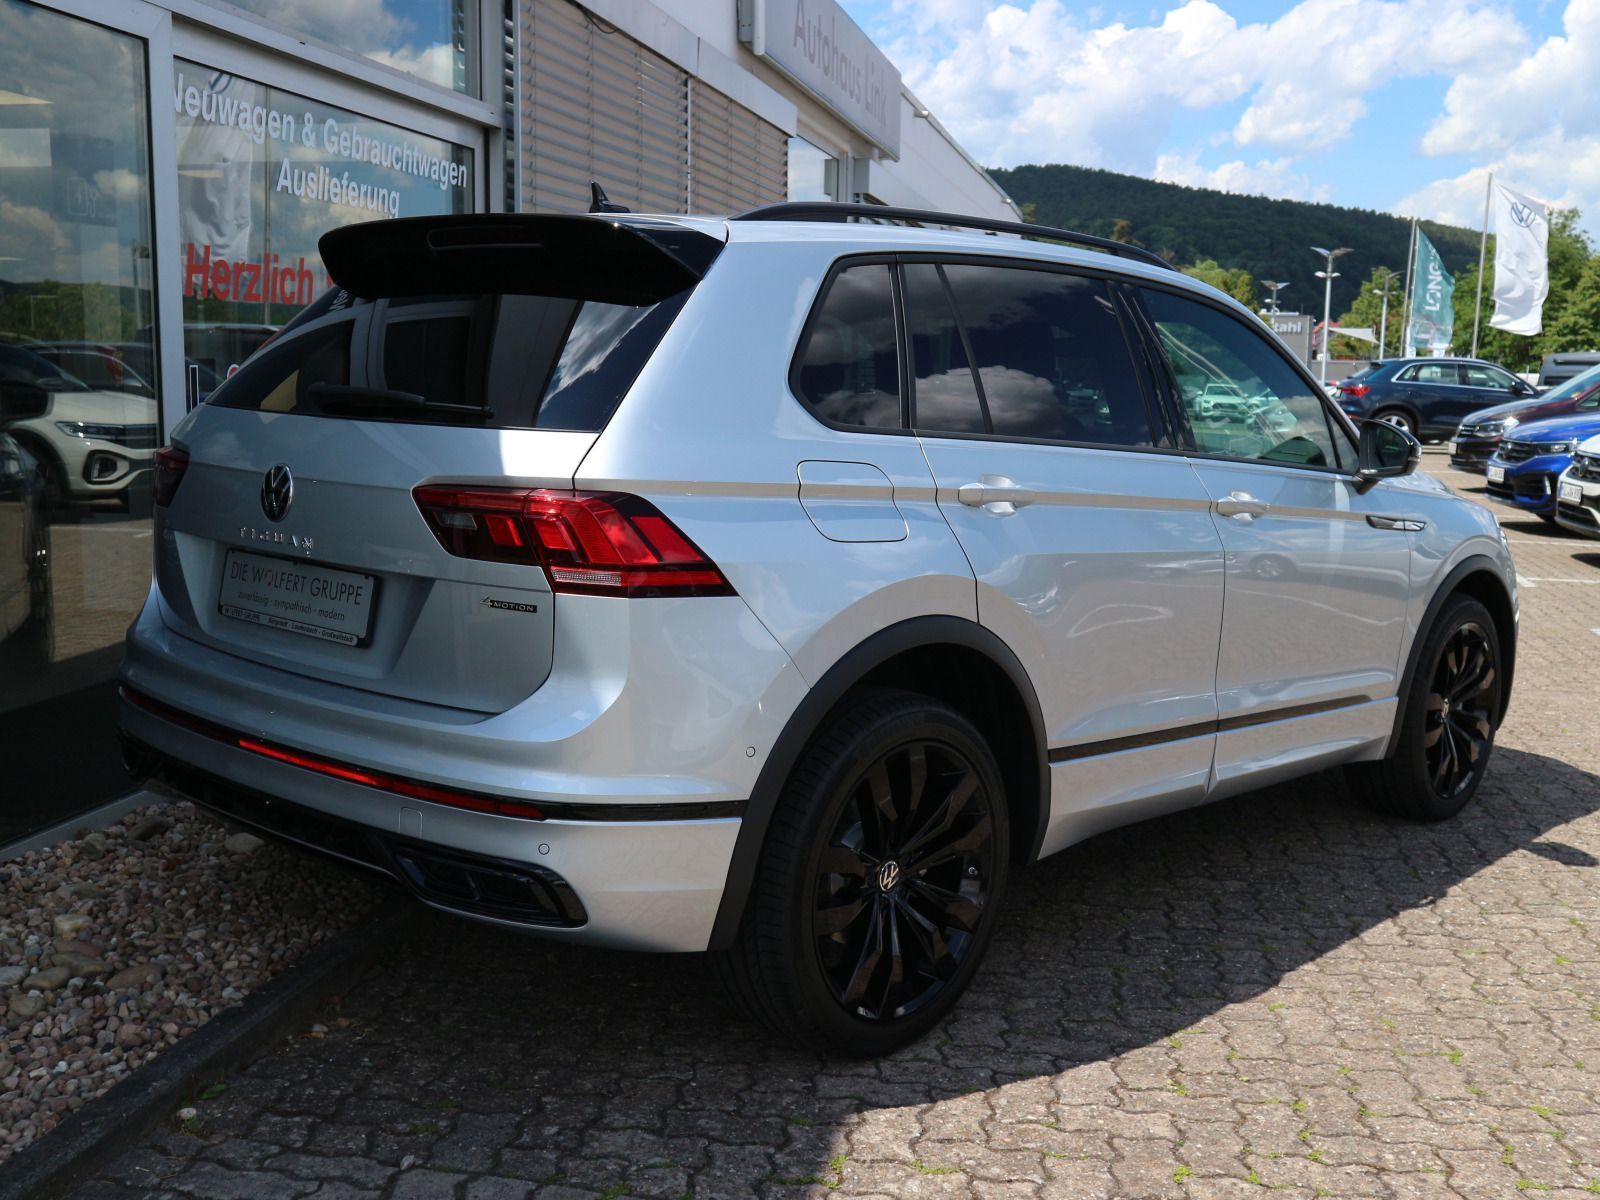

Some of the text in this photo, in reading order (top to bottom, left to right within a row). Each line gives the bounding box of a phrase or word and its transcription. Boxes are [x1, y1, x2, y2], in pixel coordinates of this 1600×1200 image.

[793, 0, 861, 104] Autohaus
[302, 111, 315, 149] &
[323, 118, 467, 190] Gebrauchtwagen
[276, 157, 400, 219] Auslieferung
[184, 242, 314, 305] Herzlich
[230, 561, 364, 606] DIE WOLFERT GRUPPE
[318, 607, 345, 622] modern
[480, 596, 535, 612] 4MOTION
